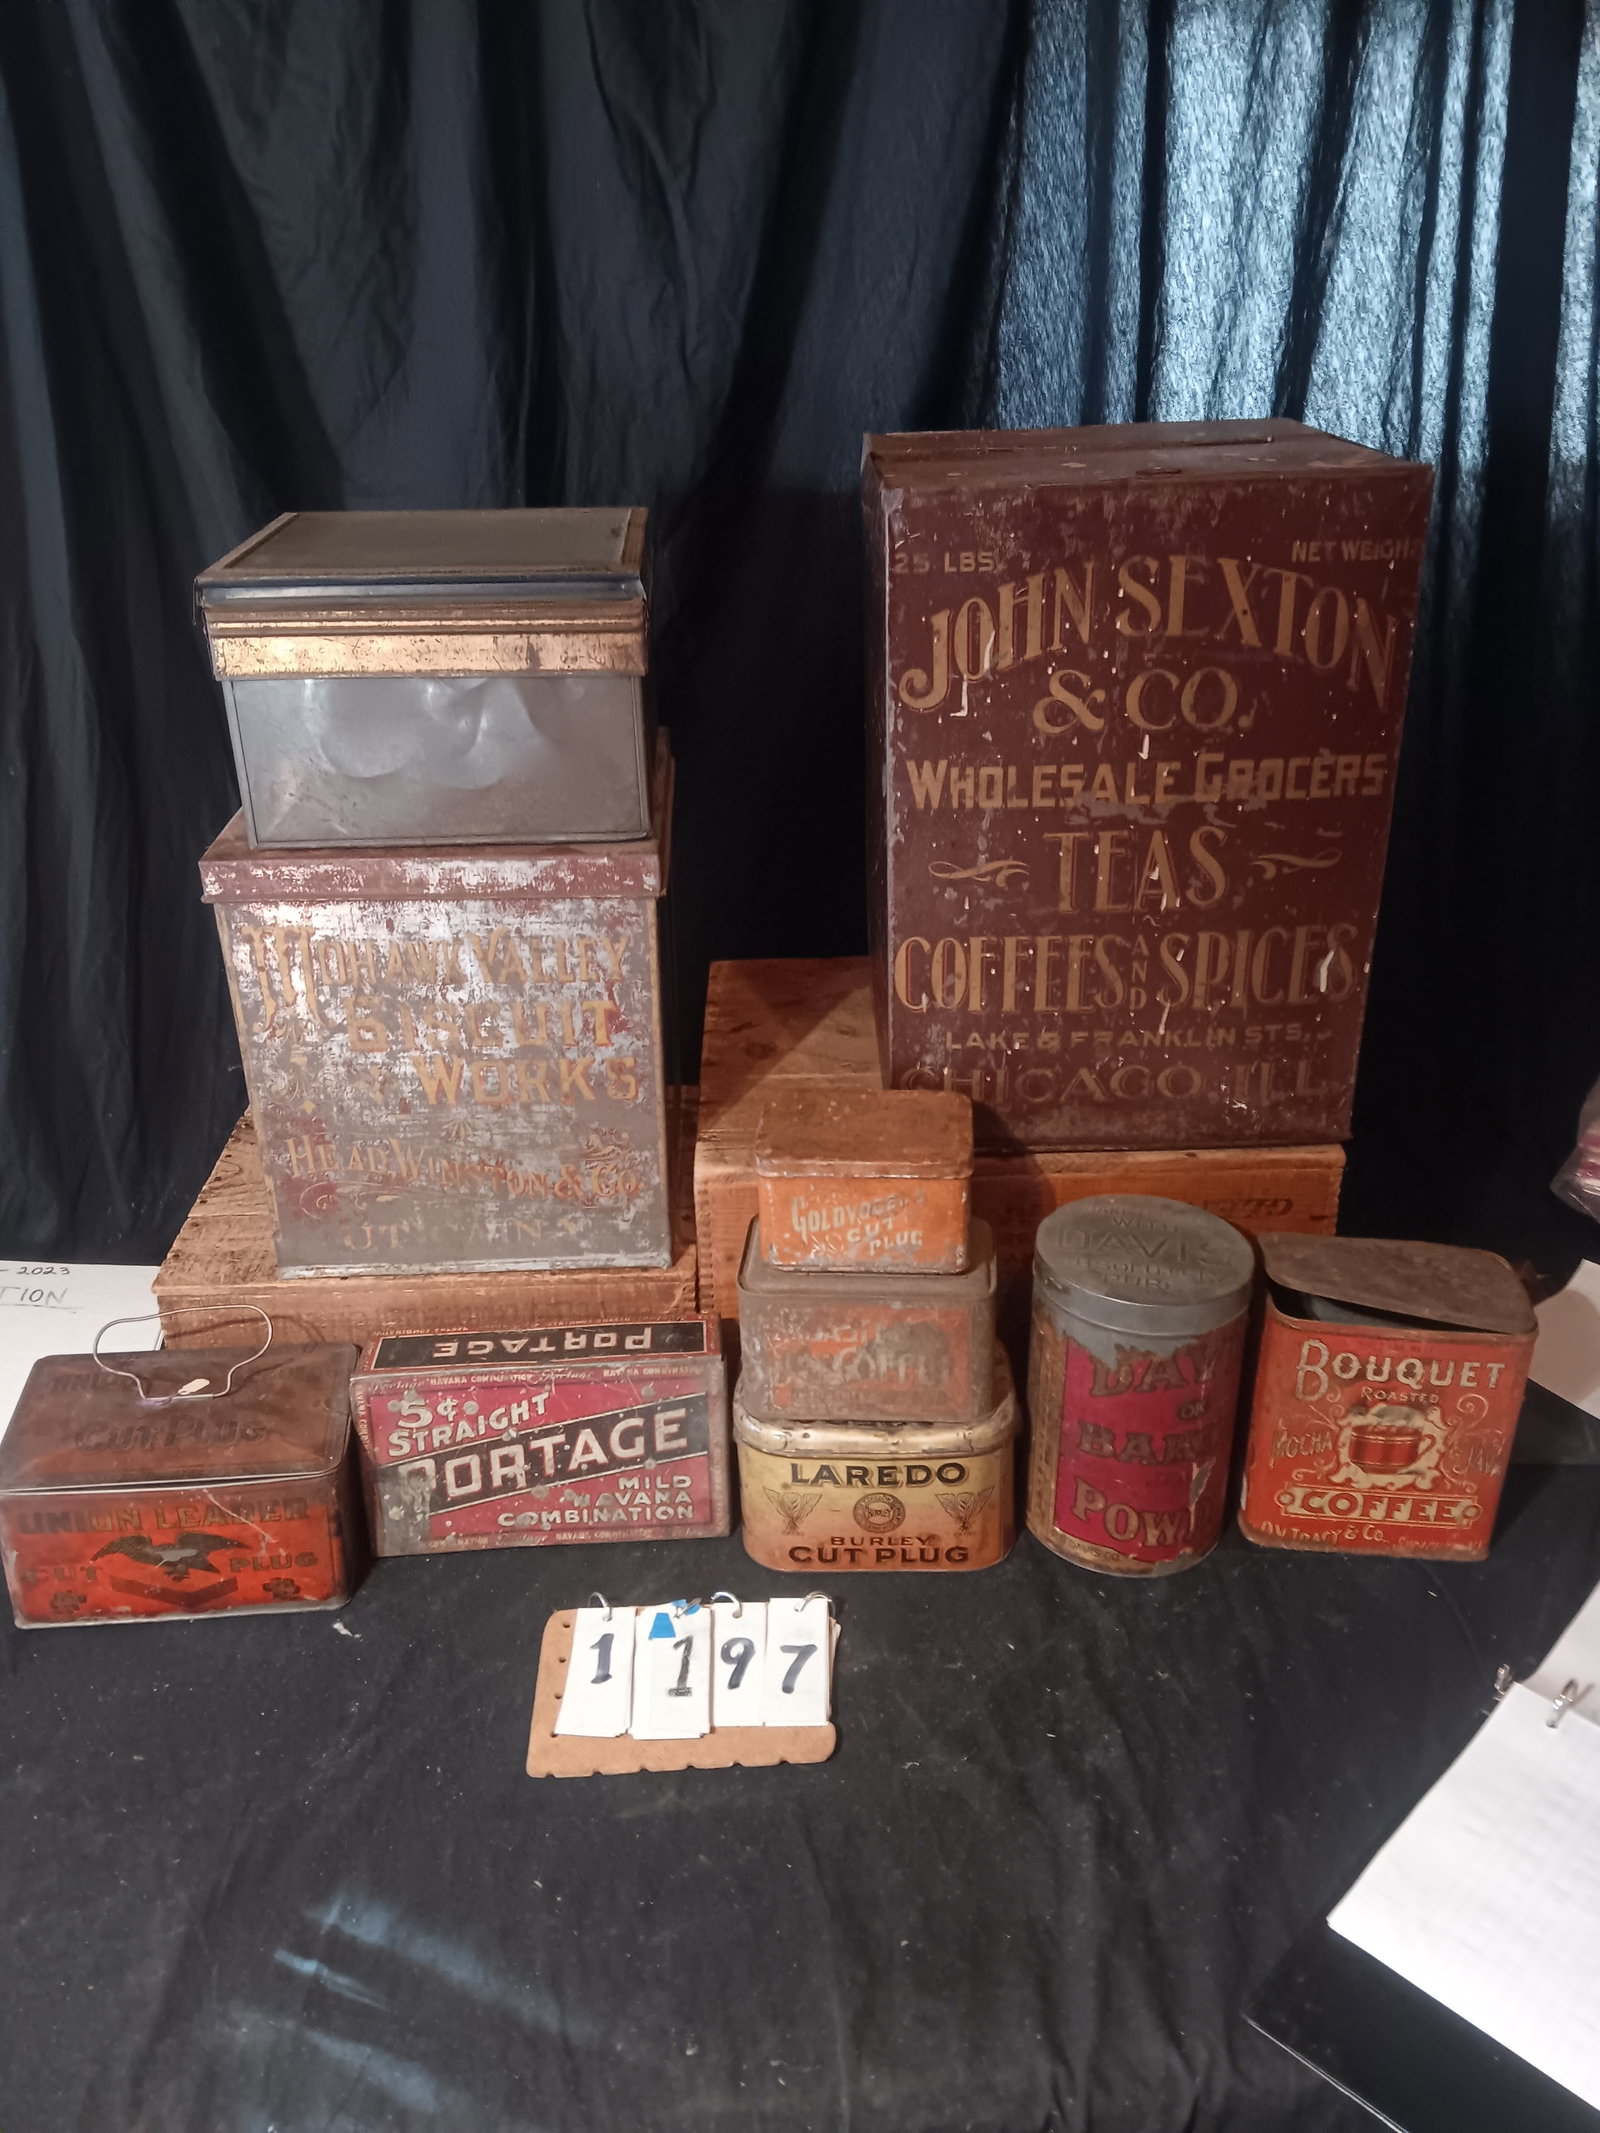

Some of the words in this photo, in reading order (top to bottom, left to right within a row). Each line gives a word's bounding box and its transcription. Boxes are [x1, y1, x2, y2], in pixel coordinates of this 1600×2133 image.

[893, 553, 930, 574] 25
[1291, 541, 1336, 562] NET
[899, 562, 1096, 711] JOHN
[1115, 555, 1398, 712] SEXTON
[1033, 669, 1106, 735] &
[906, 759, 1181, 809] WHOLESALE
[1197, 752, 1388, 803] GROCERS
[1044, 825, 1229, 914] TEAS
[241, 924, 468, 1036] MOHAWK
[468, 926, 629, 984] VALLEY
[894, 934, 1129, 1013] COFFEES
[1157, 923, 1360, 1013] SPICES
[343, 995, 624, 1053] BISCUIT
[945, 1031, 1030, 1051] LAKE
[1070, 1027, 1237, 1050] FRANKLIN
[413, 1055, 638, 1107] WORKS
[553, 1163, 586, 1198] &
[847, 1217, 895, 1243] CUT
[869, 1230, 923, 1257] PLUG
[16, 1266, 71, 1276] 2023
[433, 1327, 652, 1359] PORTAGE
[1294, 1339, 1505, 1401] BOUQUET
[1360, 1385, 1440, 1405] ROASTED
[387, 1391, 551, 1457] STRAIGHT
[395, 1397, 459, 1429] 5¢
[397, 1407, 689, 1499] PORTAGE
[618, 1475, 693, 1491] MILD
[790, 1461, 970, 1489] LAREDO
[574, 1490, 695, 1508] HAVANA
[1301, 1490, 1462, 1525] COFFEE
[18, 1506, 144, 1534] UNION
[156, 1497, 310, 1530] LEADER
[496, 1505, 695, 1528] COMBINATION
[830, 1536, 931, 1547] BURLEY
[1343, 1525, 1359, 1541] &
[229, 1550, 319, 1573] PLUG
[788, 1546, 864, 1564] CUT
[875, 1547, 970, 1564] PLUG
